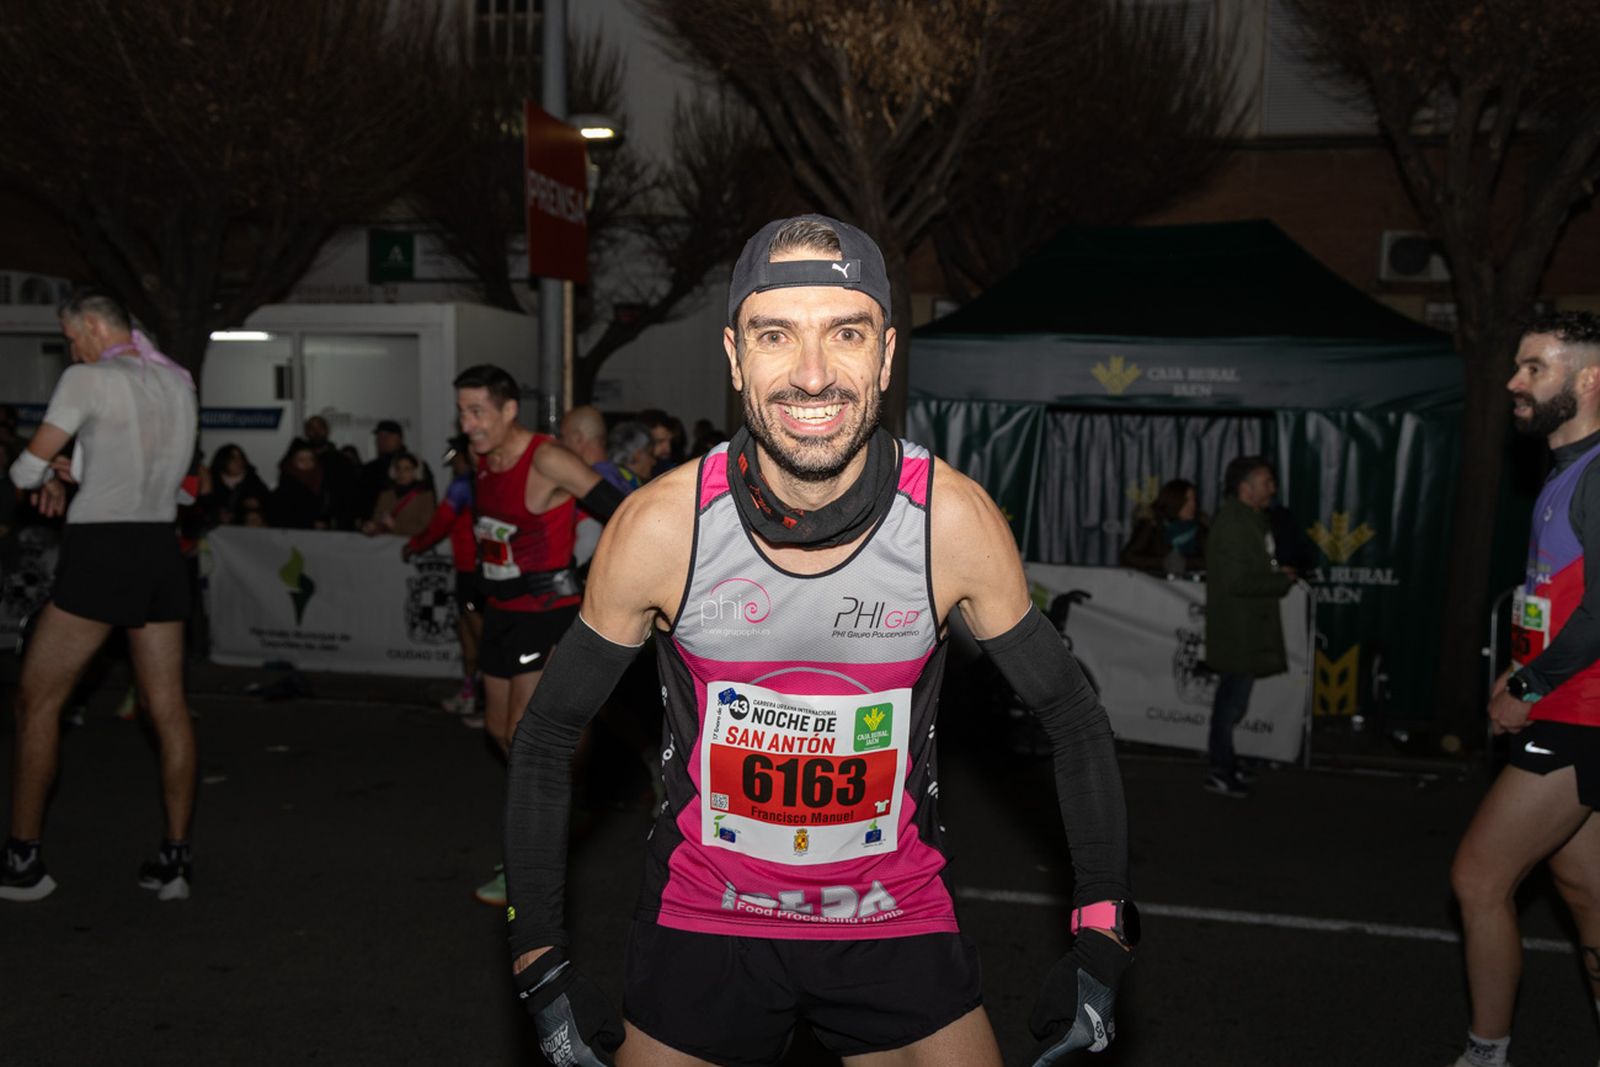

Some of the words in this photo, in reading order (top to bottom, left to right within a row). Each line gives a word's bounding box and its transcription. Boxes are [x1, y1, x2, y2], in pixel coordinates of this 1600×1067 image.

[1147, 367, 1184, 381] CAJA
[1187, 368, 1240, 383] RURAL
[1330, 566, 1400, 586] RURAL
[730, 699, 748, 713] 43
[753, 699, 776, 709] CARRERA
[776, 703, 797, 712] URBANA
[797, 707, 836, 716] INTERNACIONAL
[752, 707, 810, 732] NOCHE
[813, 717, 837, 733] DE
[1146, 707, 1206, 725] CIUDAD
[726, 726, 765, 749] SAN
[767, 733, 835, 754] ANTÓN
[857, 732, 870, 741] CAJA
[743, 754, 867, 808] 6163
[751, 806, 807, 824] Francisco
[811, 809, 854, 824] Manuel
[737, 902, 773, 917] Food
